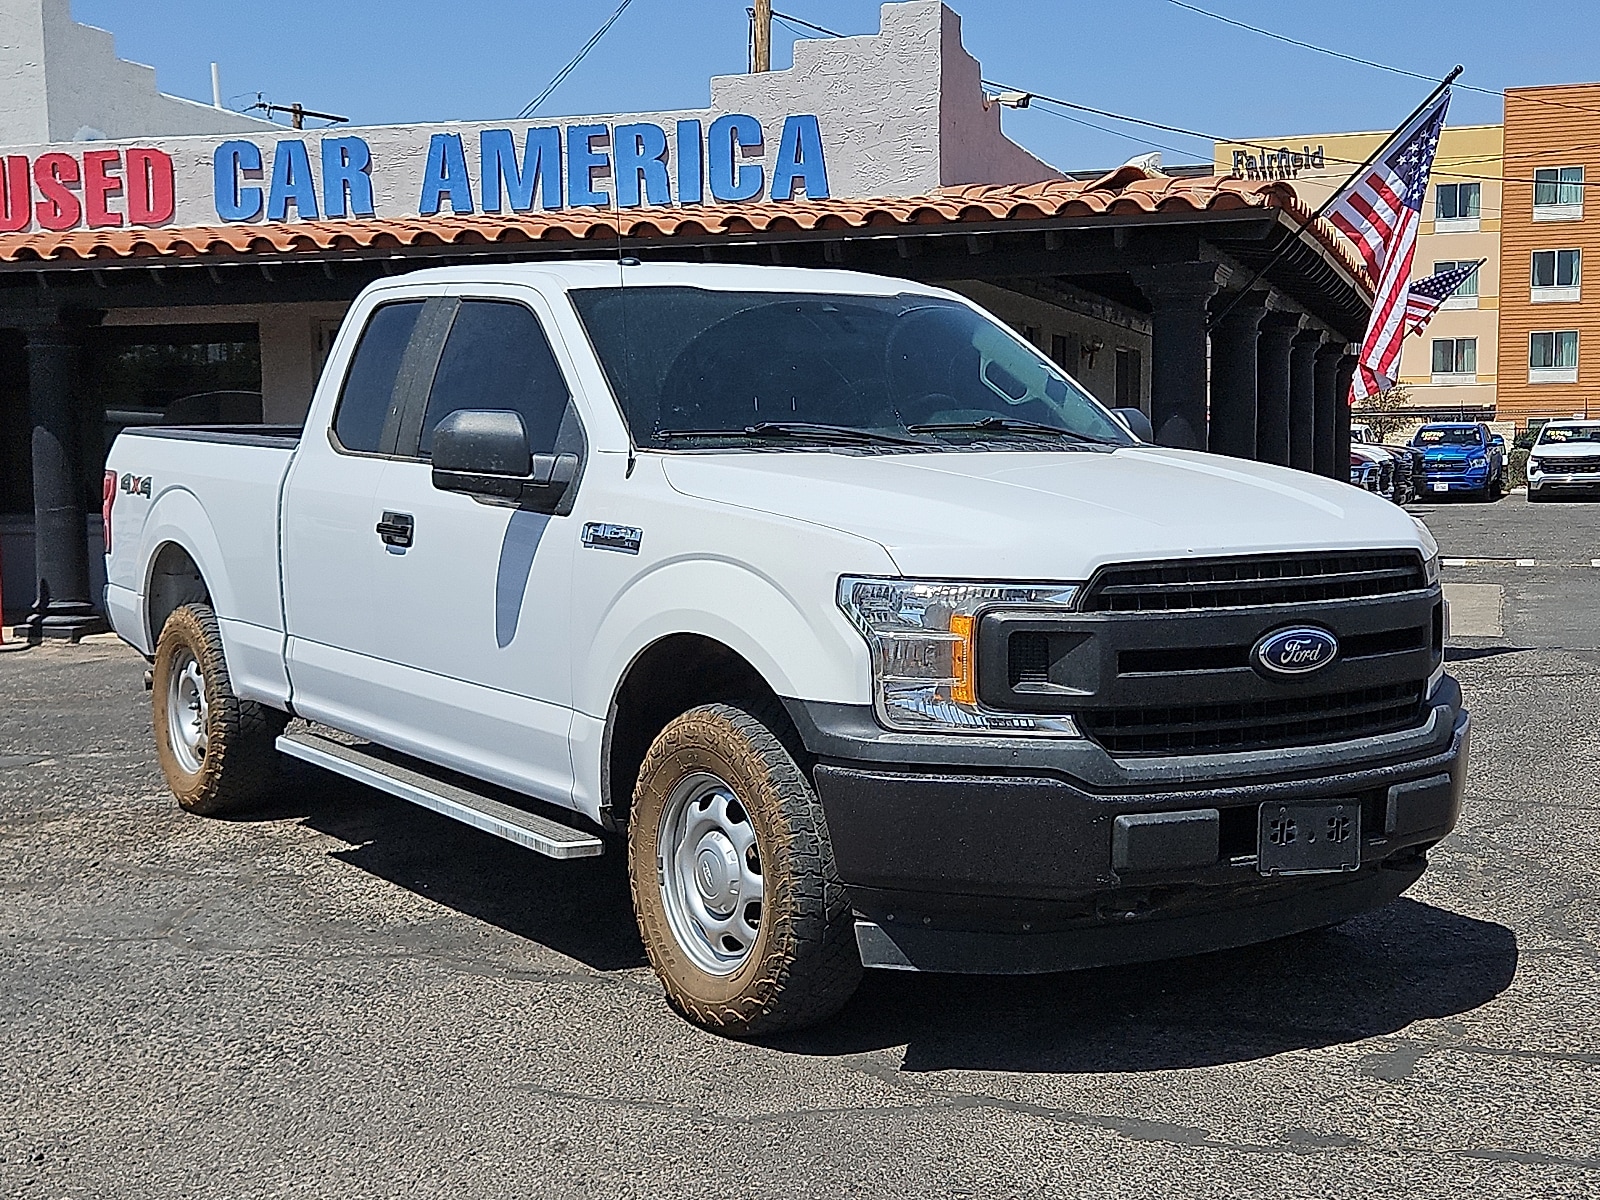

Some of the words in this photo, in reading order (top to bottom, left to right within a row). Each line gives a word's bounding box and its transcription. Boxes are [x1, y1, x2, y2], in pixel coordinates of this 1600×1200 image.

[1232, 145, 1325, 170] Fairfield
[0, 148, 174, 232] USED
[214, 135, 375, 223] CAR
[418, 113, 831, 216] AMERICA
[1280, 638, 1323, 664] Ford
